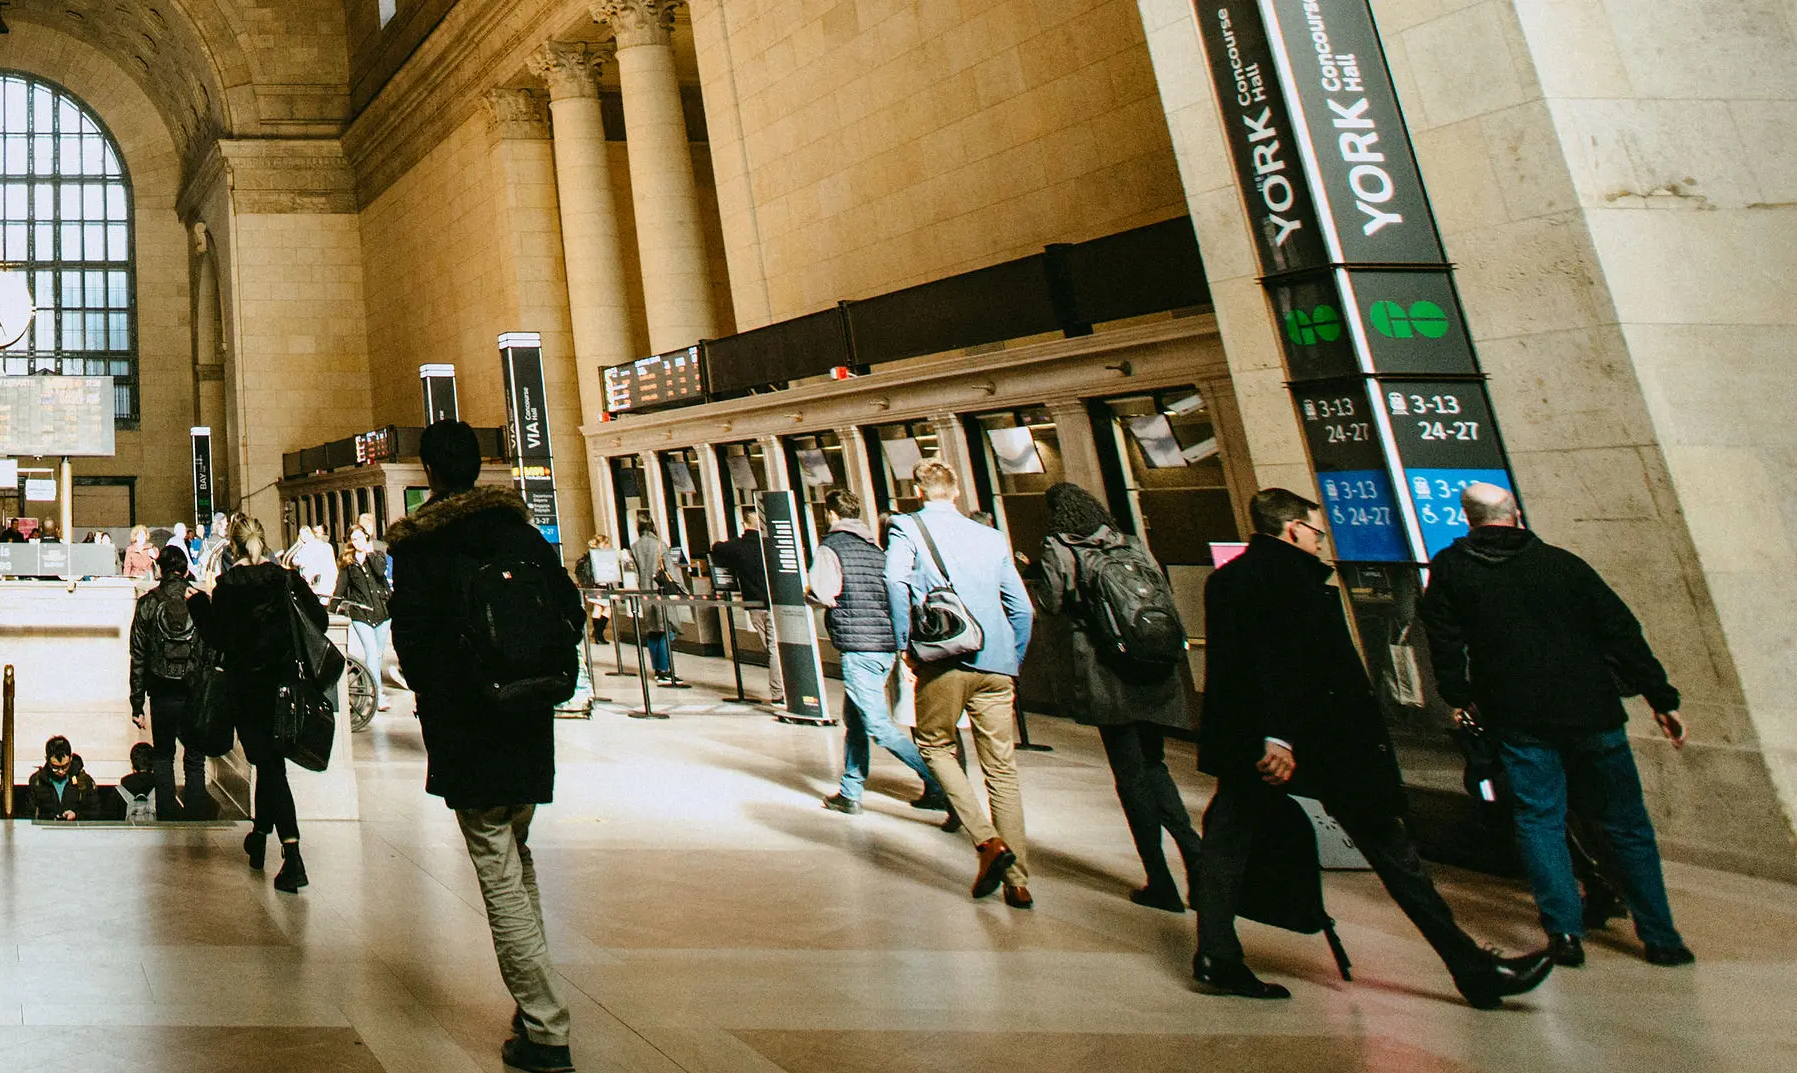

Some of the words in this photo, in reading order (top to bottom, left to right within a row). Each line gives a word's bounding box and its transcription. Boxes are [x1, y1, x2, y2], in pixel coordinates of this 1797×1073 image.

[1218, 8, 1250, 107] Concourse
[1302, 0, 1342, 92] Concours
[1245, 62, 1267, 102] Hall
[1335, 53, 1365, 92] Hall
[1242, 106, 1302, 247] YORK
[1327, 97, 1404, 237] YORK
[523, 387, 532, 421] Concourse
[1318, 397, 1355, 418] 3-13
[1410, 394, 1461, 415] 3-13
[526, 422, 541, 449] VIA
[1325, 422, 1370, 443] 24-27
[1417, 420, 1480, 441] 24-27
[1340, 479, 1379, 500] 3-13
[1348, 507, 1392, 527] 24-27
